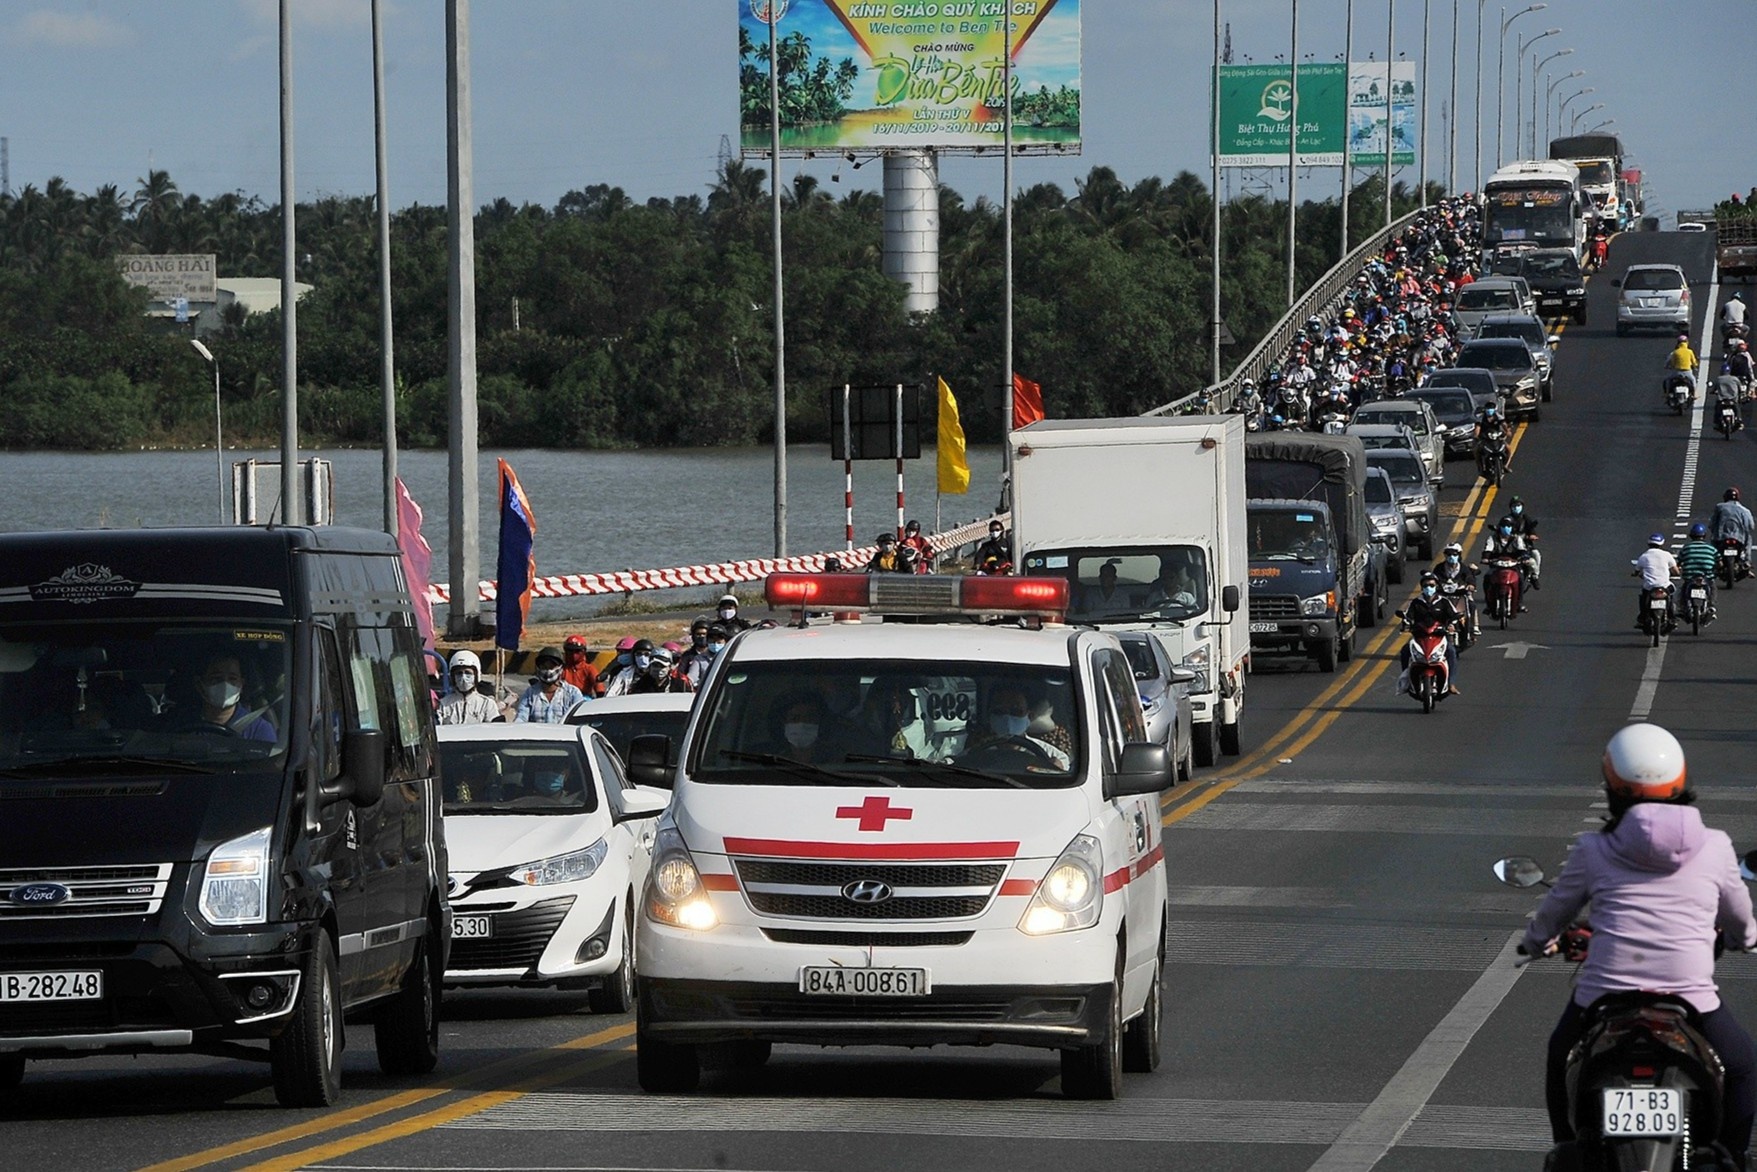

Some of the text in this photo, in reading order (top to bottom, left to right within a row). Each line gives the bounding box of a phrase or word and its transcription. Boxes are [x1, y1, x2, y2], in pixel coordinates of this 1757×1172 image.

[849, 3, 886, 18] KÍNH
[891, 3, 939, 17] CHÀO
[942, 0, 976, 17] QUÝ
[869, 22, 935, 34] Welcome
[940, 22, 955, 34] to
[959, 21, 989, 33] Ben
[913, 41, 974, 53] CHÀO MỪNG
[913, 106, 972, 120] LẦN THỨ V
[873, 122, 1007, 133] 16/11/2019 20/11/201
[1238, 124, 1255, 134] Biệt
[1303, 122, 1319, 133] Phú
[34, 585, 135, 594] AUTOKINGDOM
[23, 887, 56, 901] Ford
[451, 918, 487, 936] 5.30
[810, 970, 917, 994] 84A-008.61
[1608, 1113, 1677, 1132] 928.09
